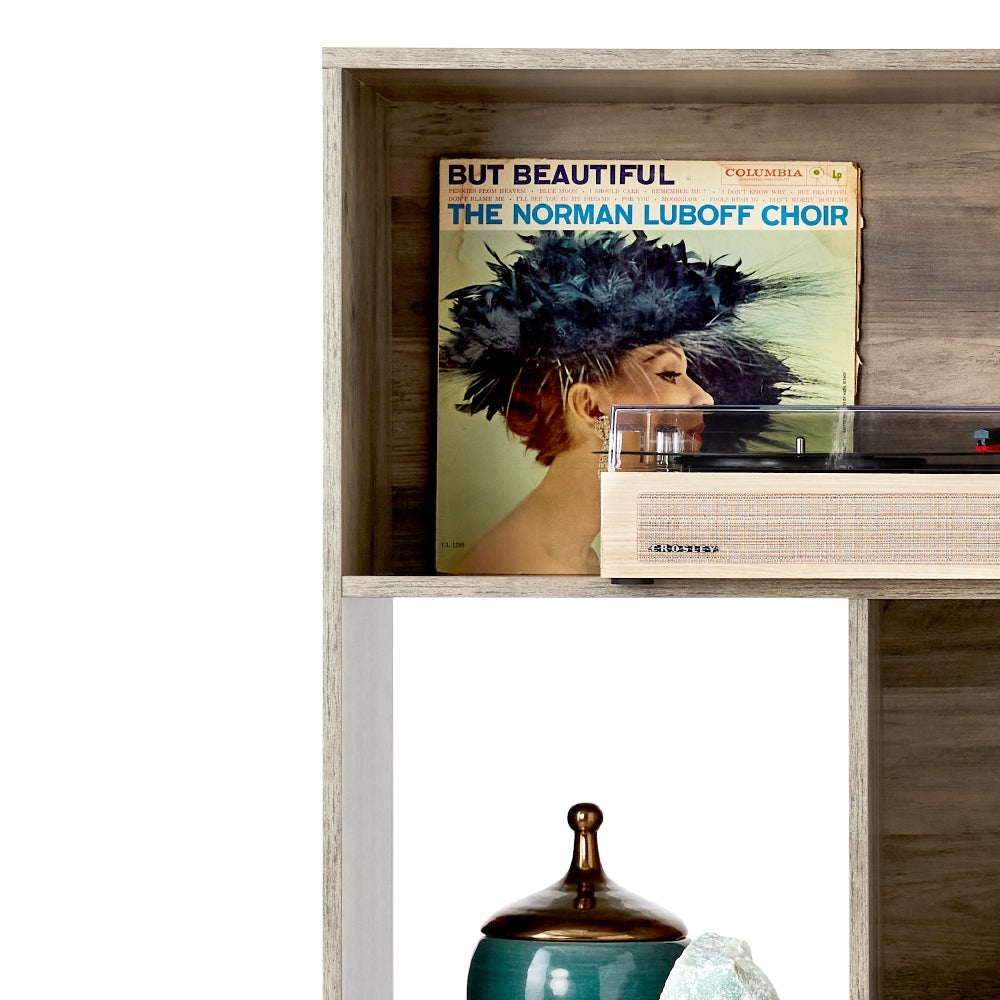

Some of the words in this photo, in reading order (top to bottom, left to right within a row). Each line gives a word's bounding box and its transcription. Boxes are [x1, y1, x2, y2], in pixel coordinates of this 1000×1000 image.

[448, 164, 505, 186] BUT
[513, 164, 676, 186] BEAUTIFUL
[725, 168, 803, 178] COLUMBIA
[447, 203, 503, 225] THE
[513, 203, 633, 225] NORMAN
[644, 204, 755, 226] LUBOFF
[761, 204, 849, 227] CHOIR
[650, 544, 718, 553] CROSLEY
